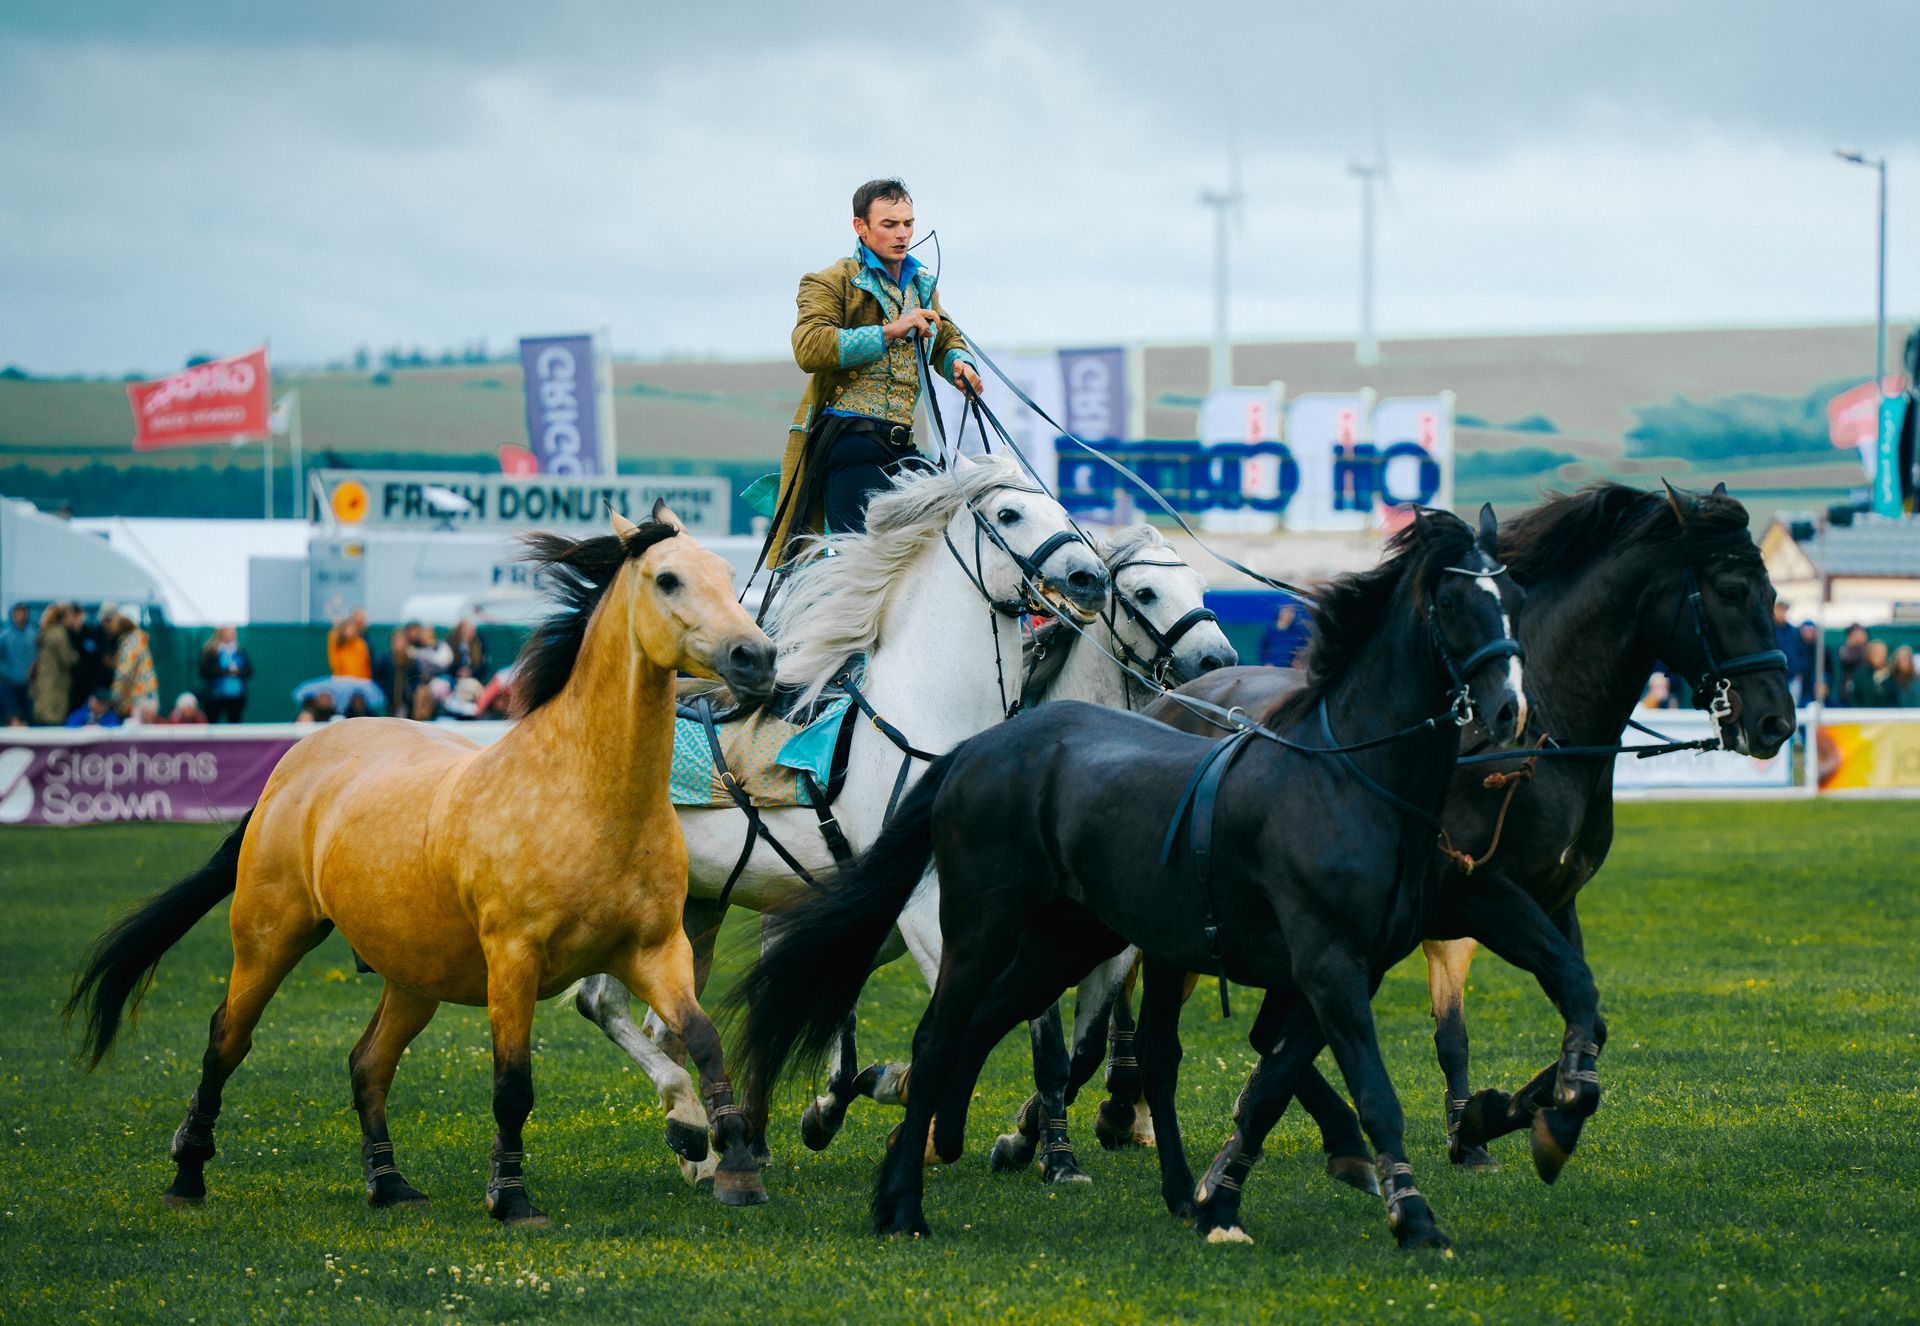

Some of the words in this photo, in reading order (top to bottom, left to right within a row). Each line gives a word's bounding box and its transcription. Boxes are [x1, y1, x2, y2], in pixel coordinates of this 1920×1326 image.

[384, 482, 485, 518] FREH
[499, 486, 629, 521] DONUTS
[46, 746, 218, 790] Stephens
[43, 784, 172, 823] Scown
